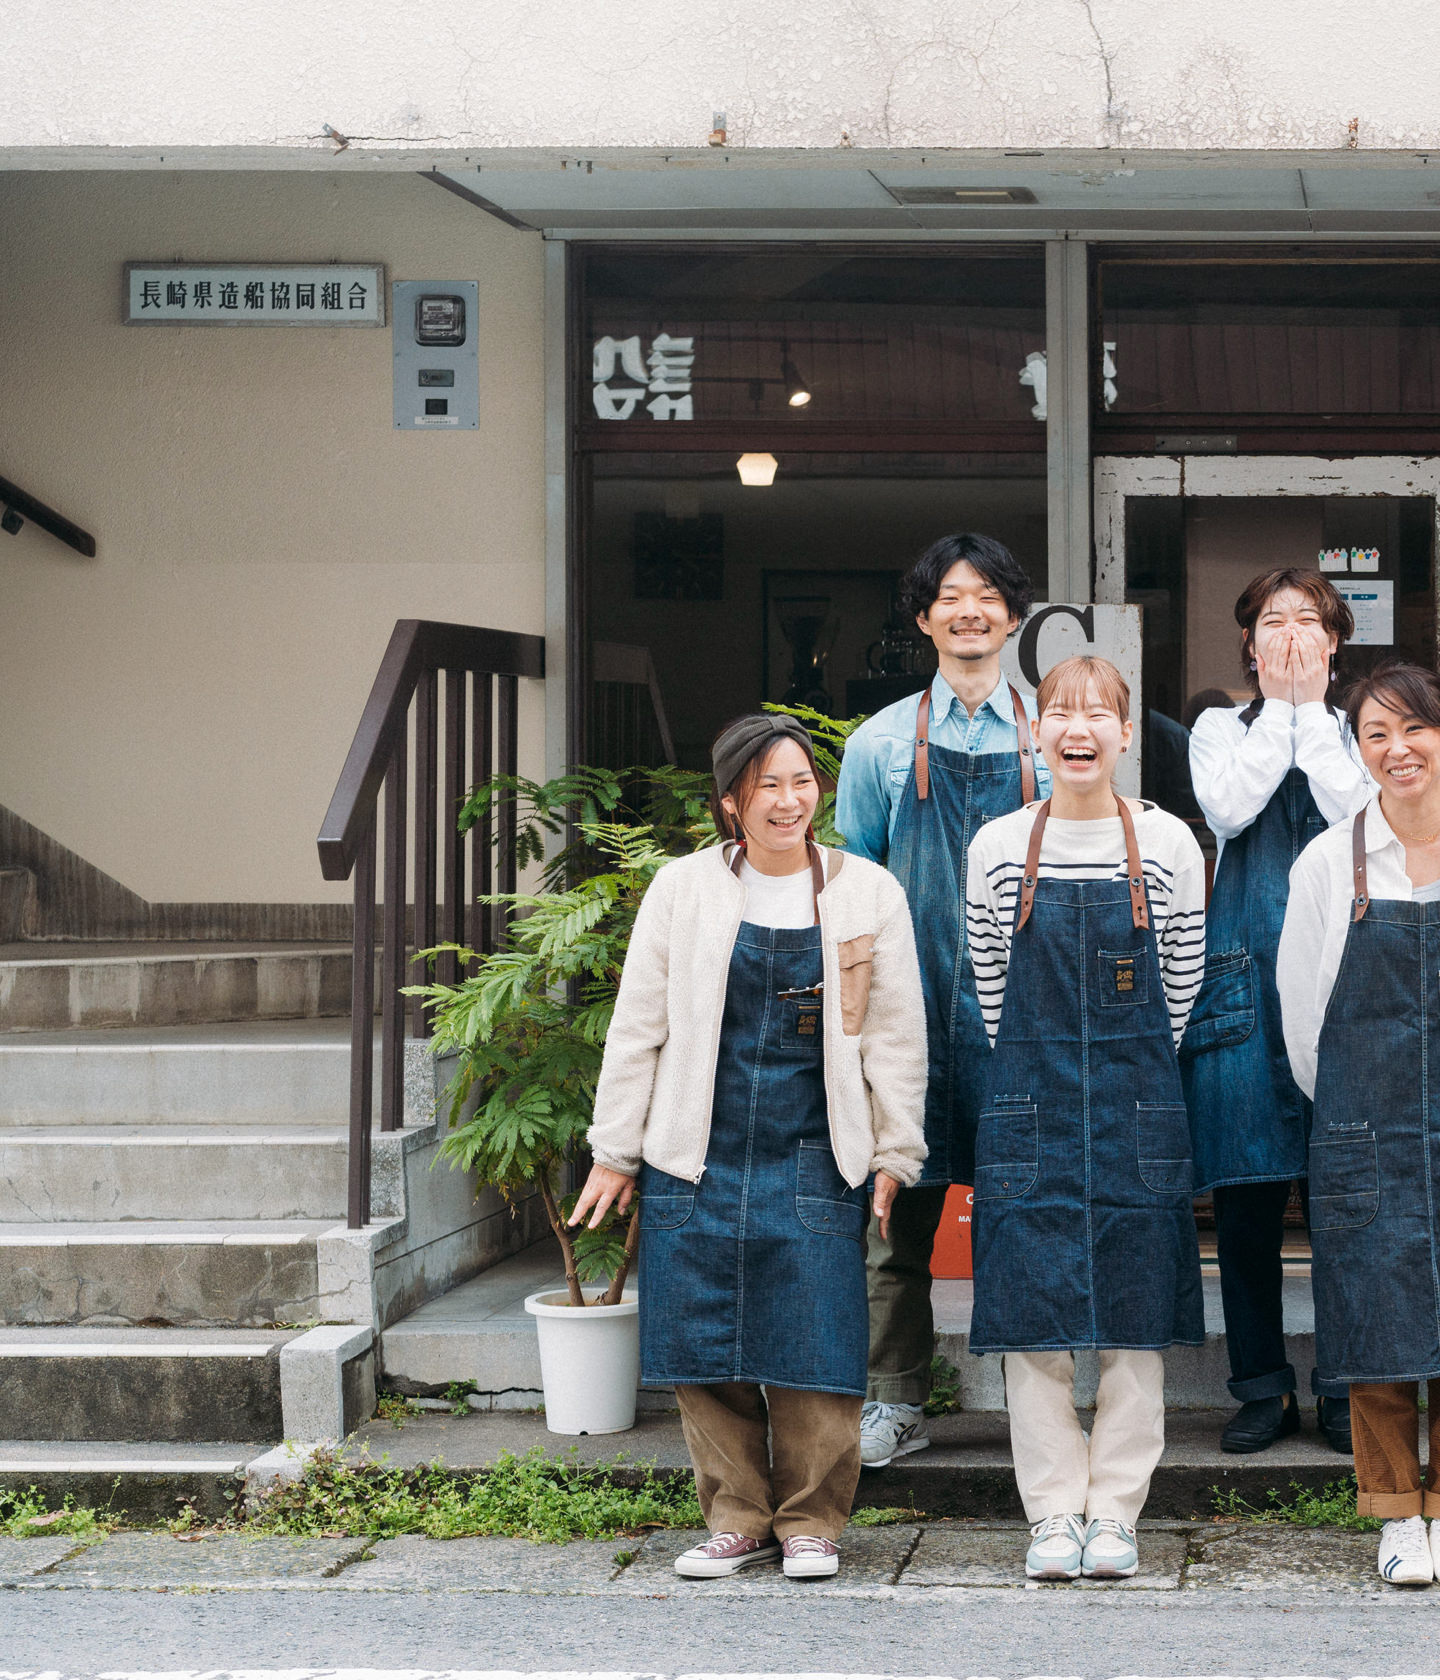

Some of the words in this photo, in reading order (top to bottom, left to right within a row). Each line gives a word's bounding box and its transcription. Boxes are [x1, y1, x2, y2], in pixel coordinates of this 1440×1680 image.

[139, 280, 368, 310] 長崎県造船協同組合
